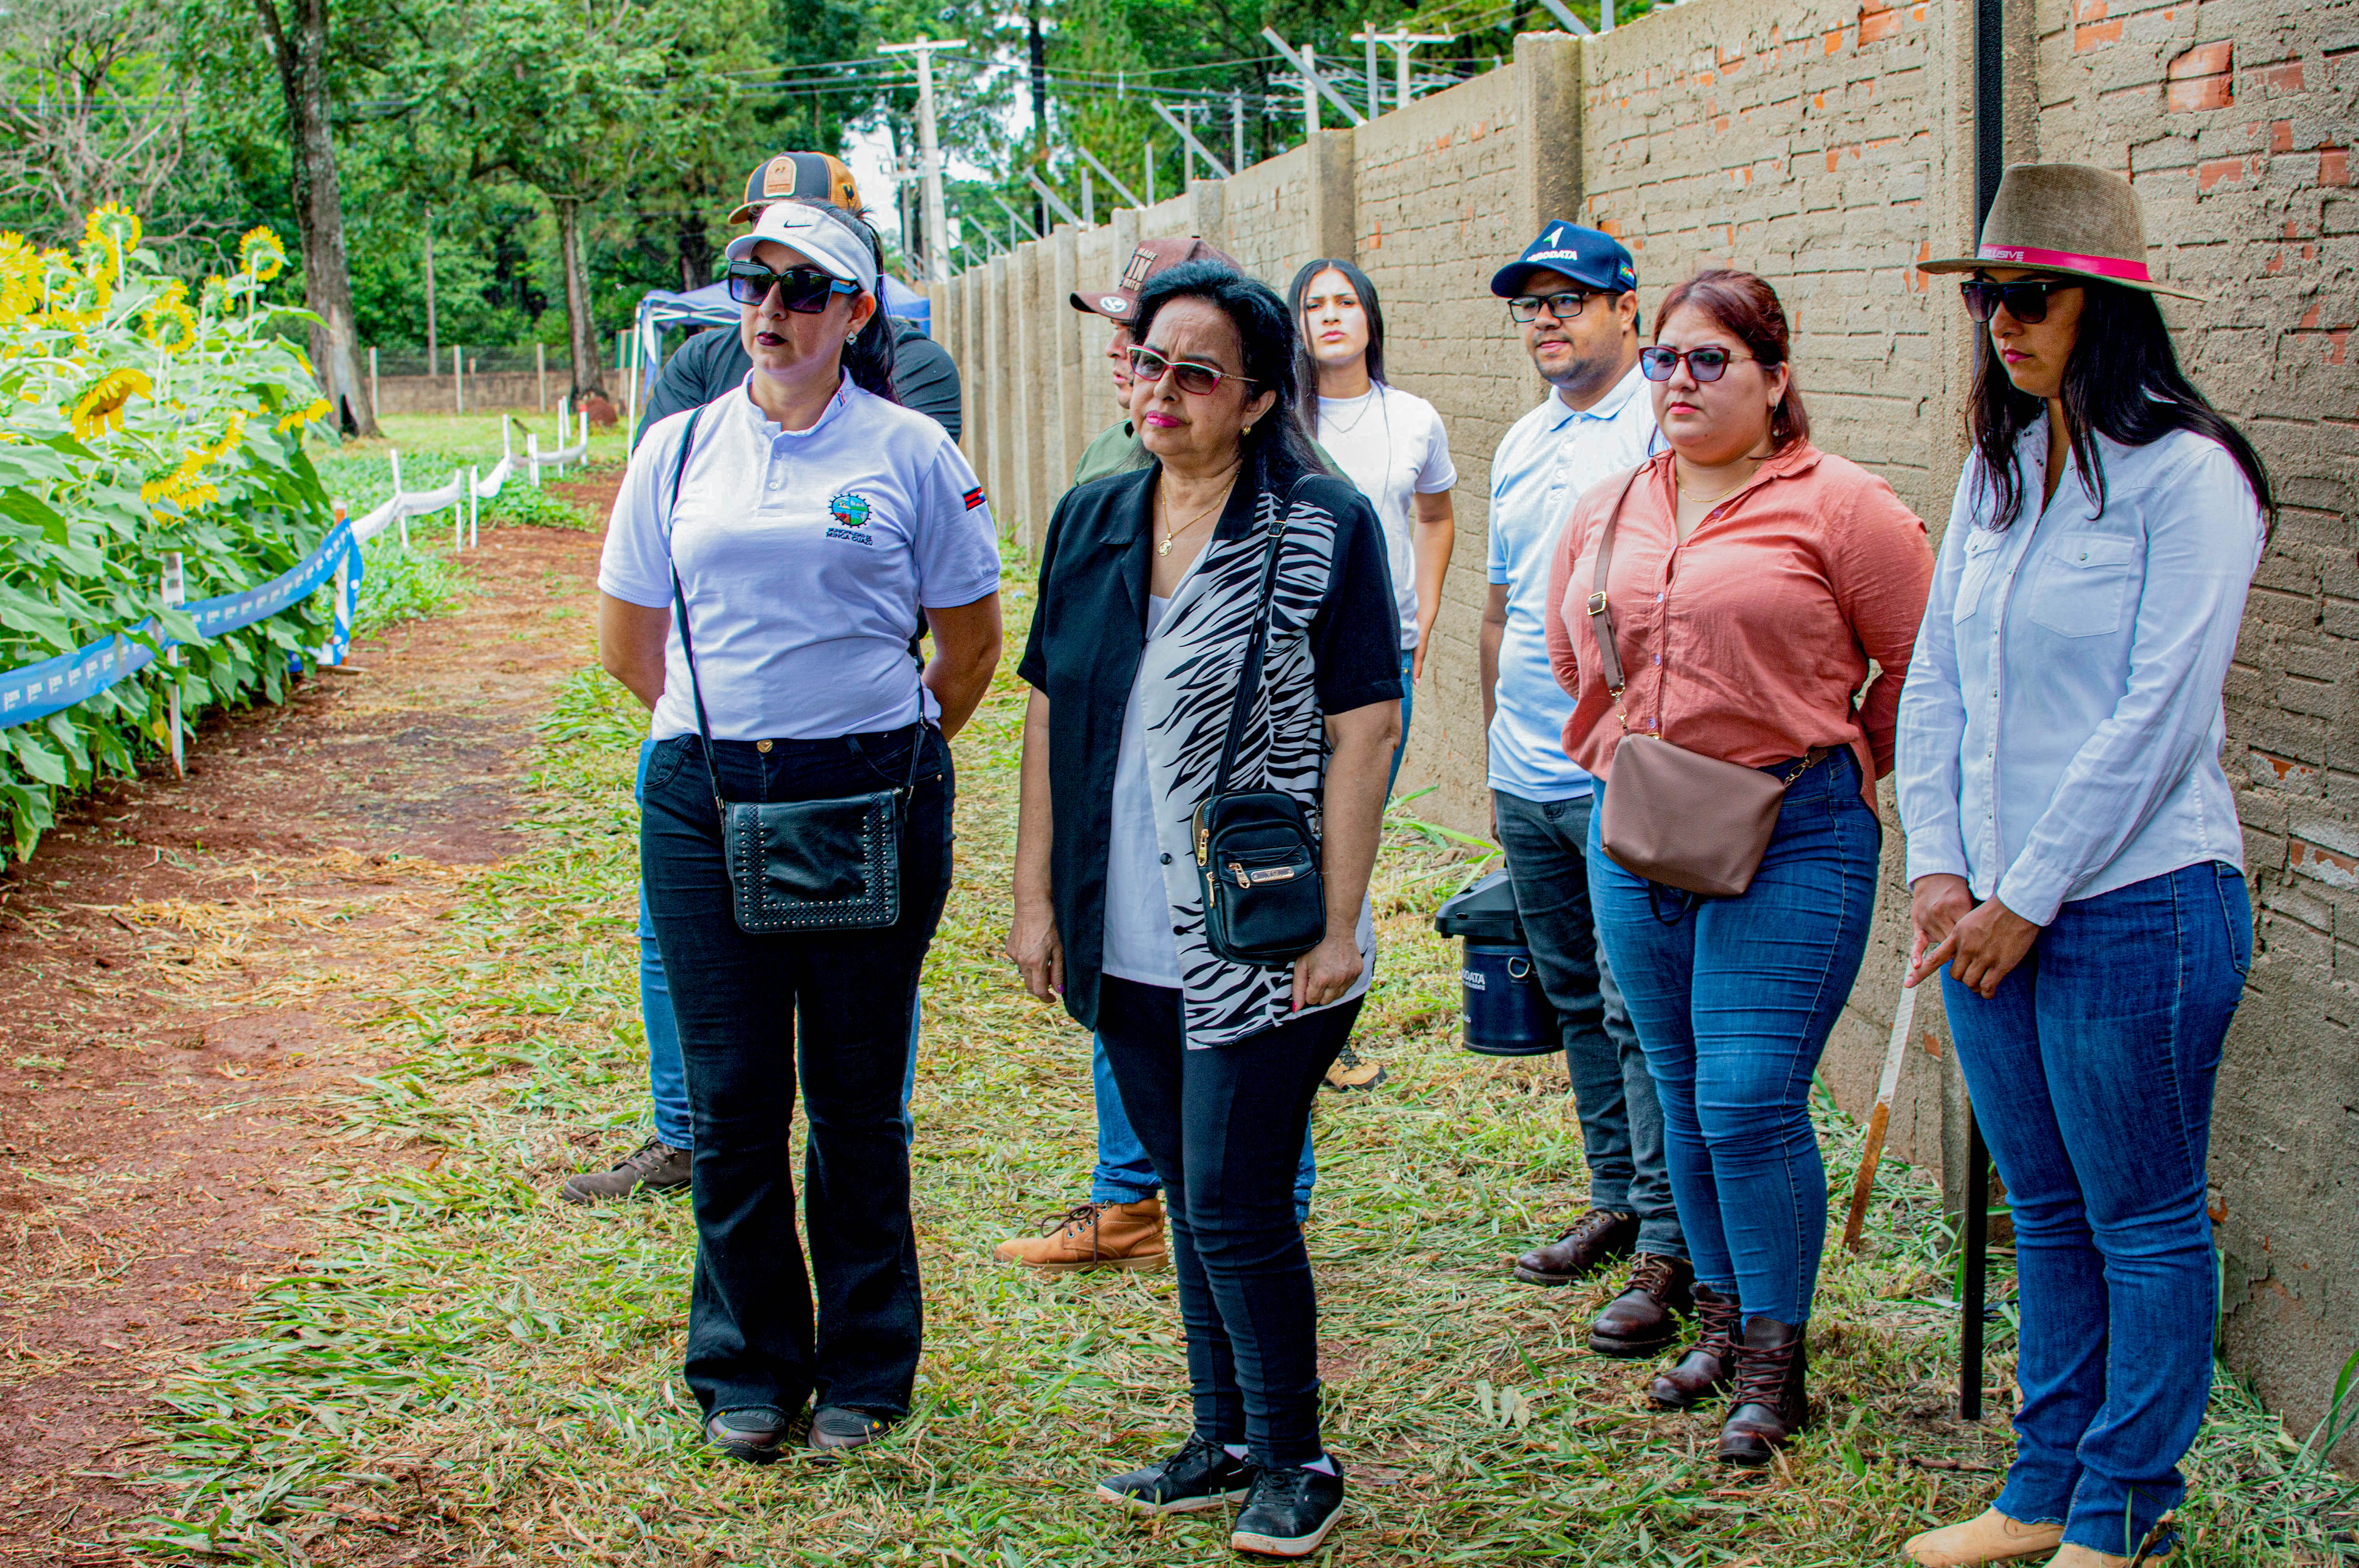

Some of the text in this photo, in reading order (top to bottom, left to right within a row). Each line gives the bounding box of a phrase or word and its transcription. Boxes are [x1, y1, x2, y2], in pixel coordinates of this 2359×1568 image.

[1137, 247, 1158, 261] MADE
[1127, 256, 1152, 282] IN
[1123, 278, 1141, 292] MATO
[826, 532, 850, 540] MINGA
